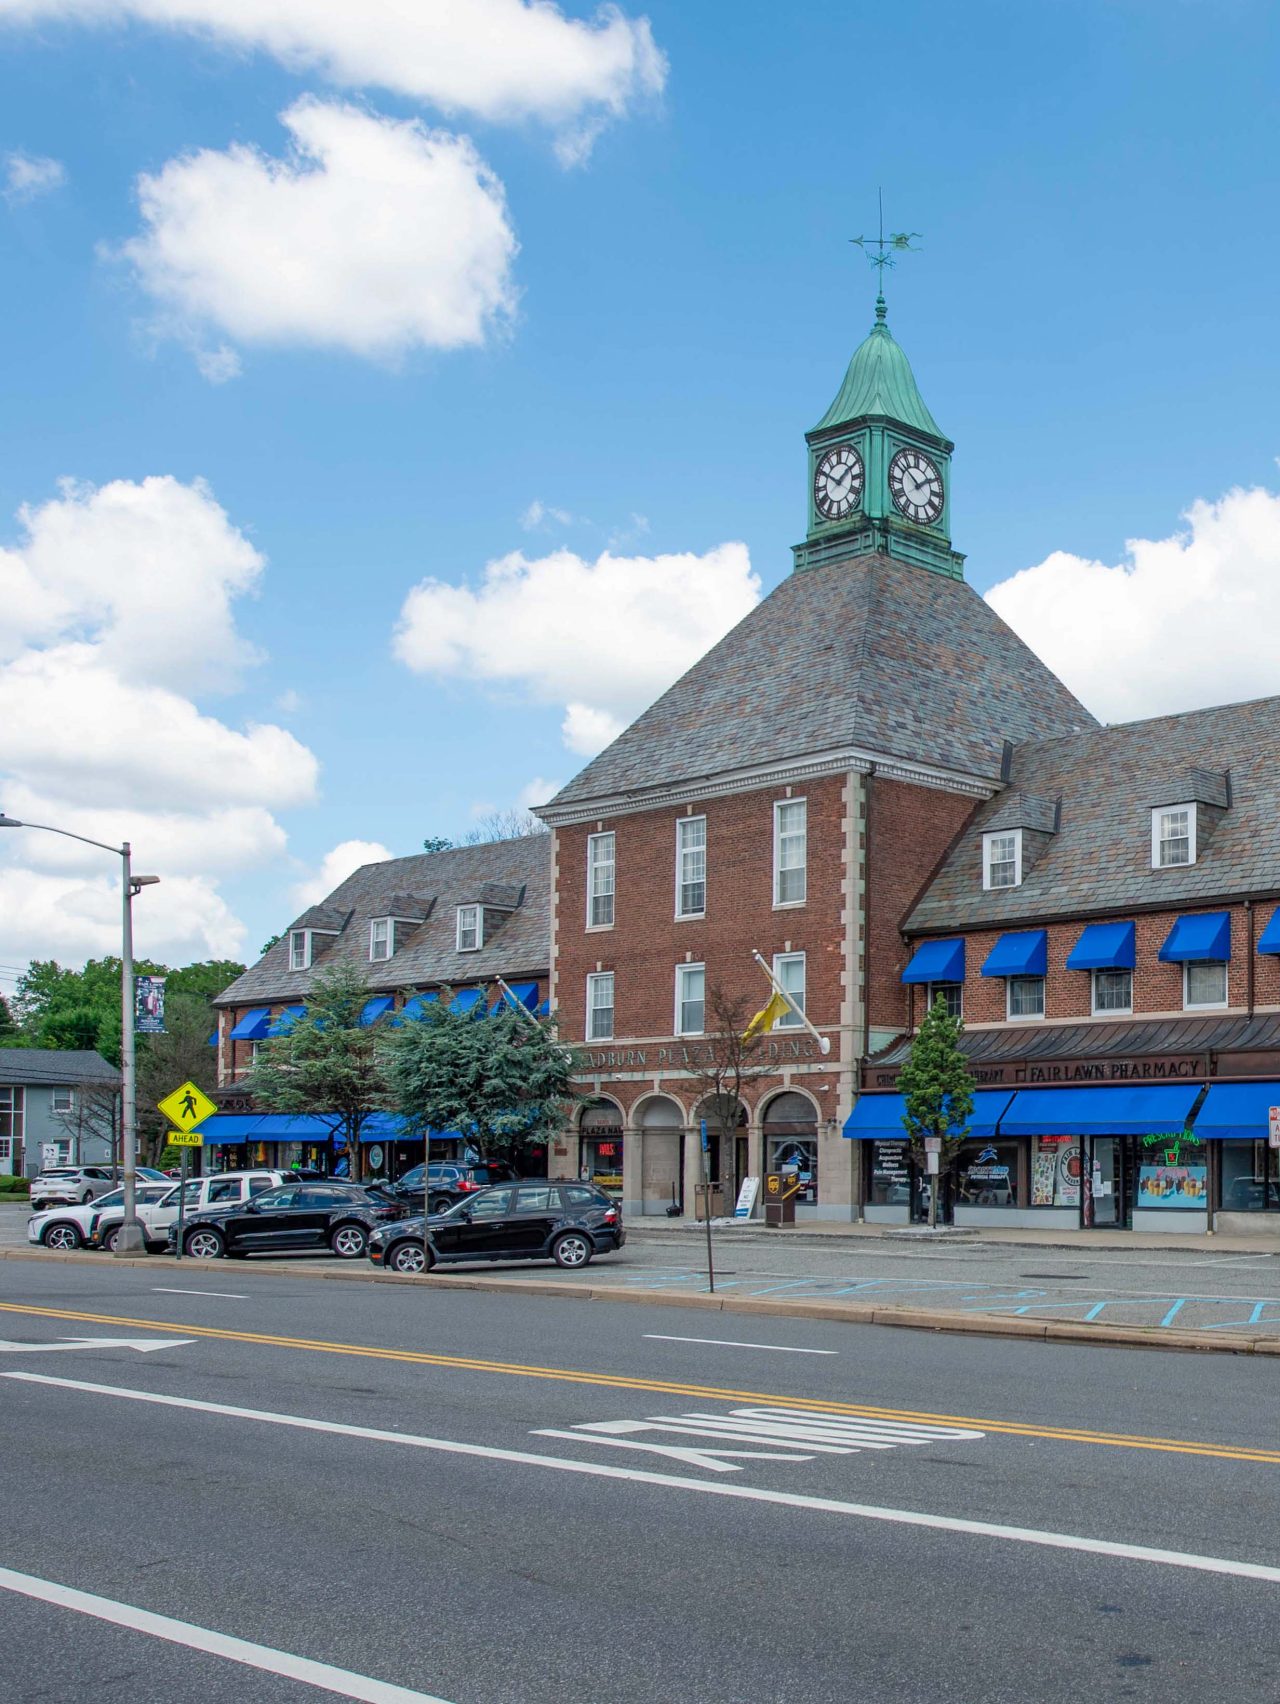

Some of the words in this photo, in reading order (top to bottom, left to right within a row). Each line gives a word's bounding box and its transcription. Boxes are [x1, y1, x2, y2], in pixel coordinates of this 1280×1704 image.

[659, 1045, 716, 1064] PLAZA
[1111, 1060, 1199, 1079] PHARMACY
[583, 1126, 607, 1135] PLAZA
[174, 1134, 199, 1144] AHEAD
